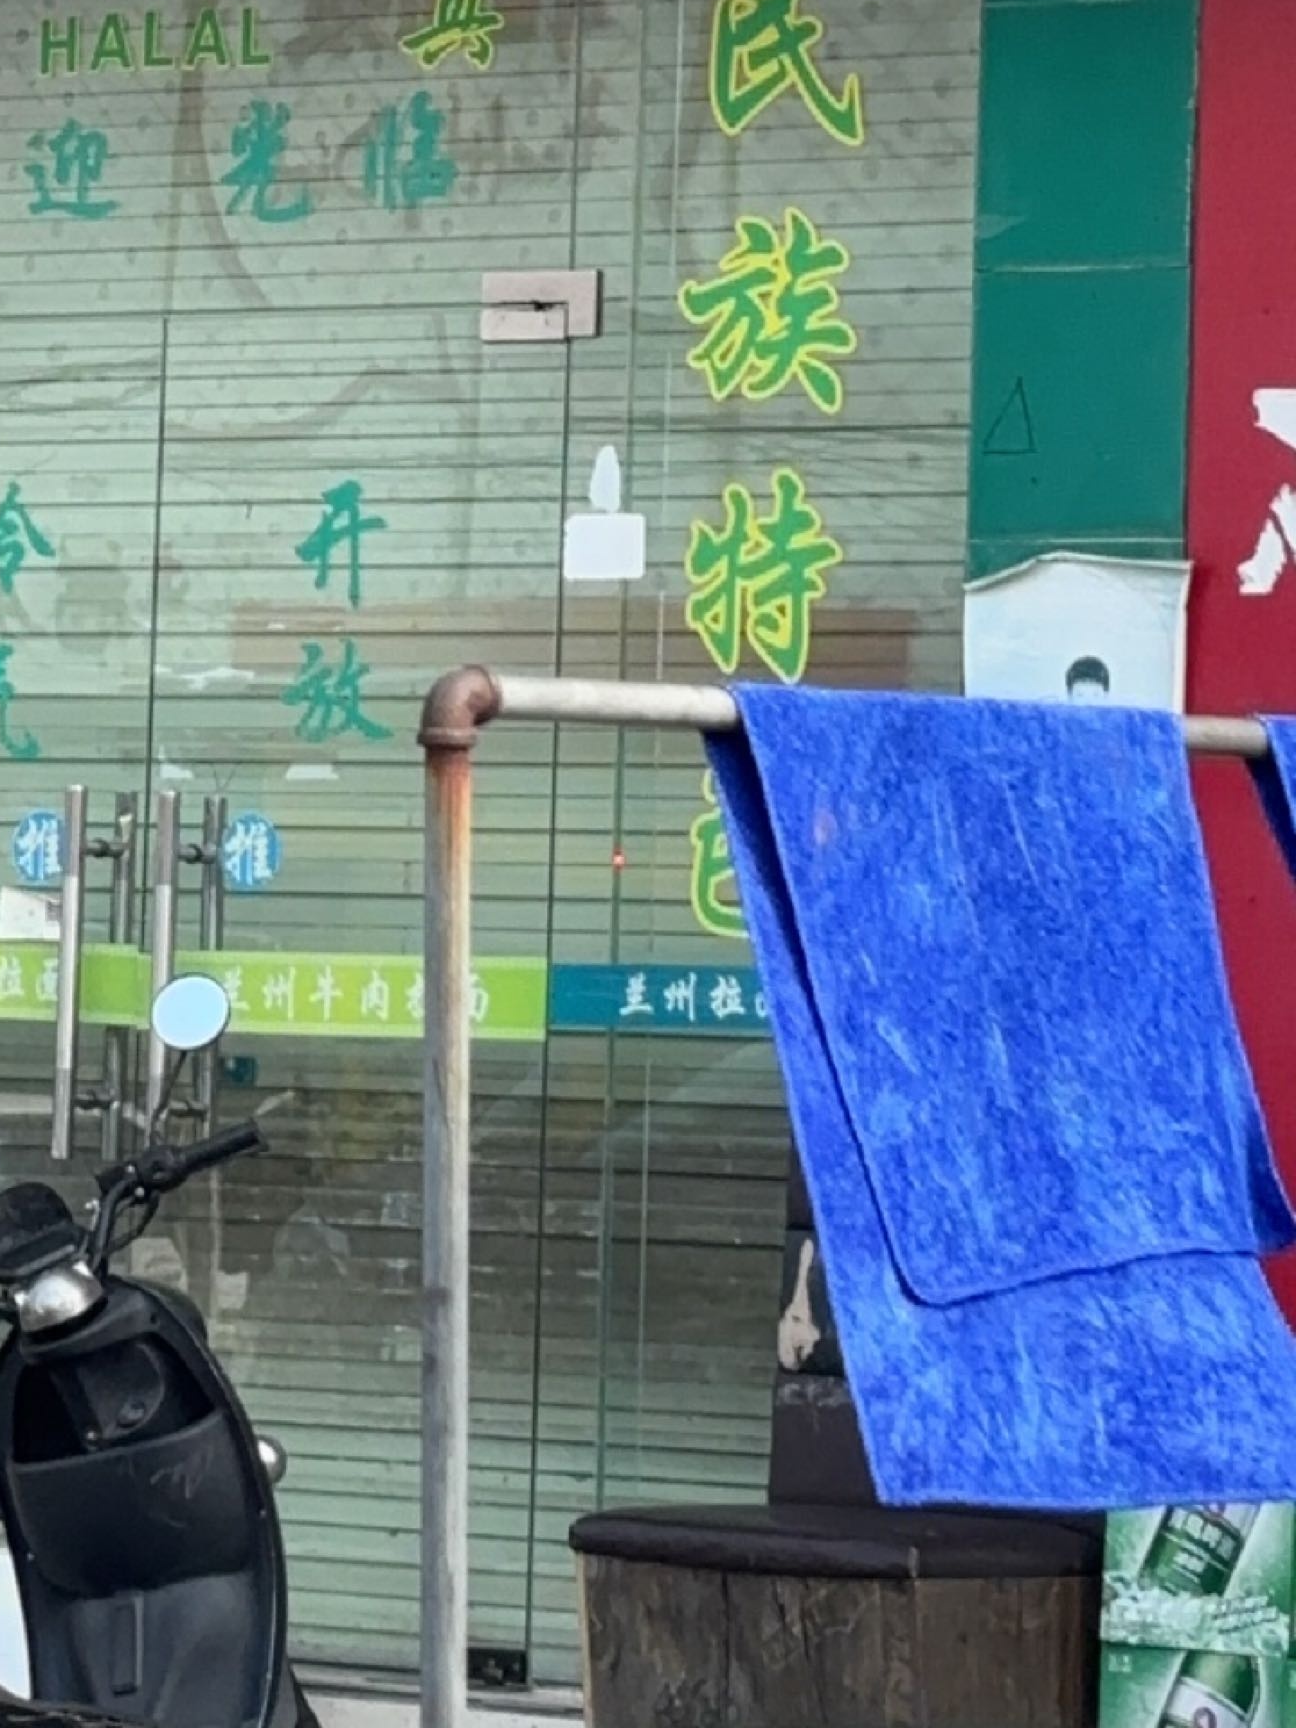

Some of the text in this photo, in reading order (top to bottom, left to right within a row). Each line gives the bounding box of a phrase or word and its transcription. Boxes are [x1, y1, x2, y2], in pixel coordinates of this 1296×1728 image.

[39, 7, 272, 75] HALAL
[281, 479, 395, 743] 开放
[619, 972, 772, 1022] 兰州拉
